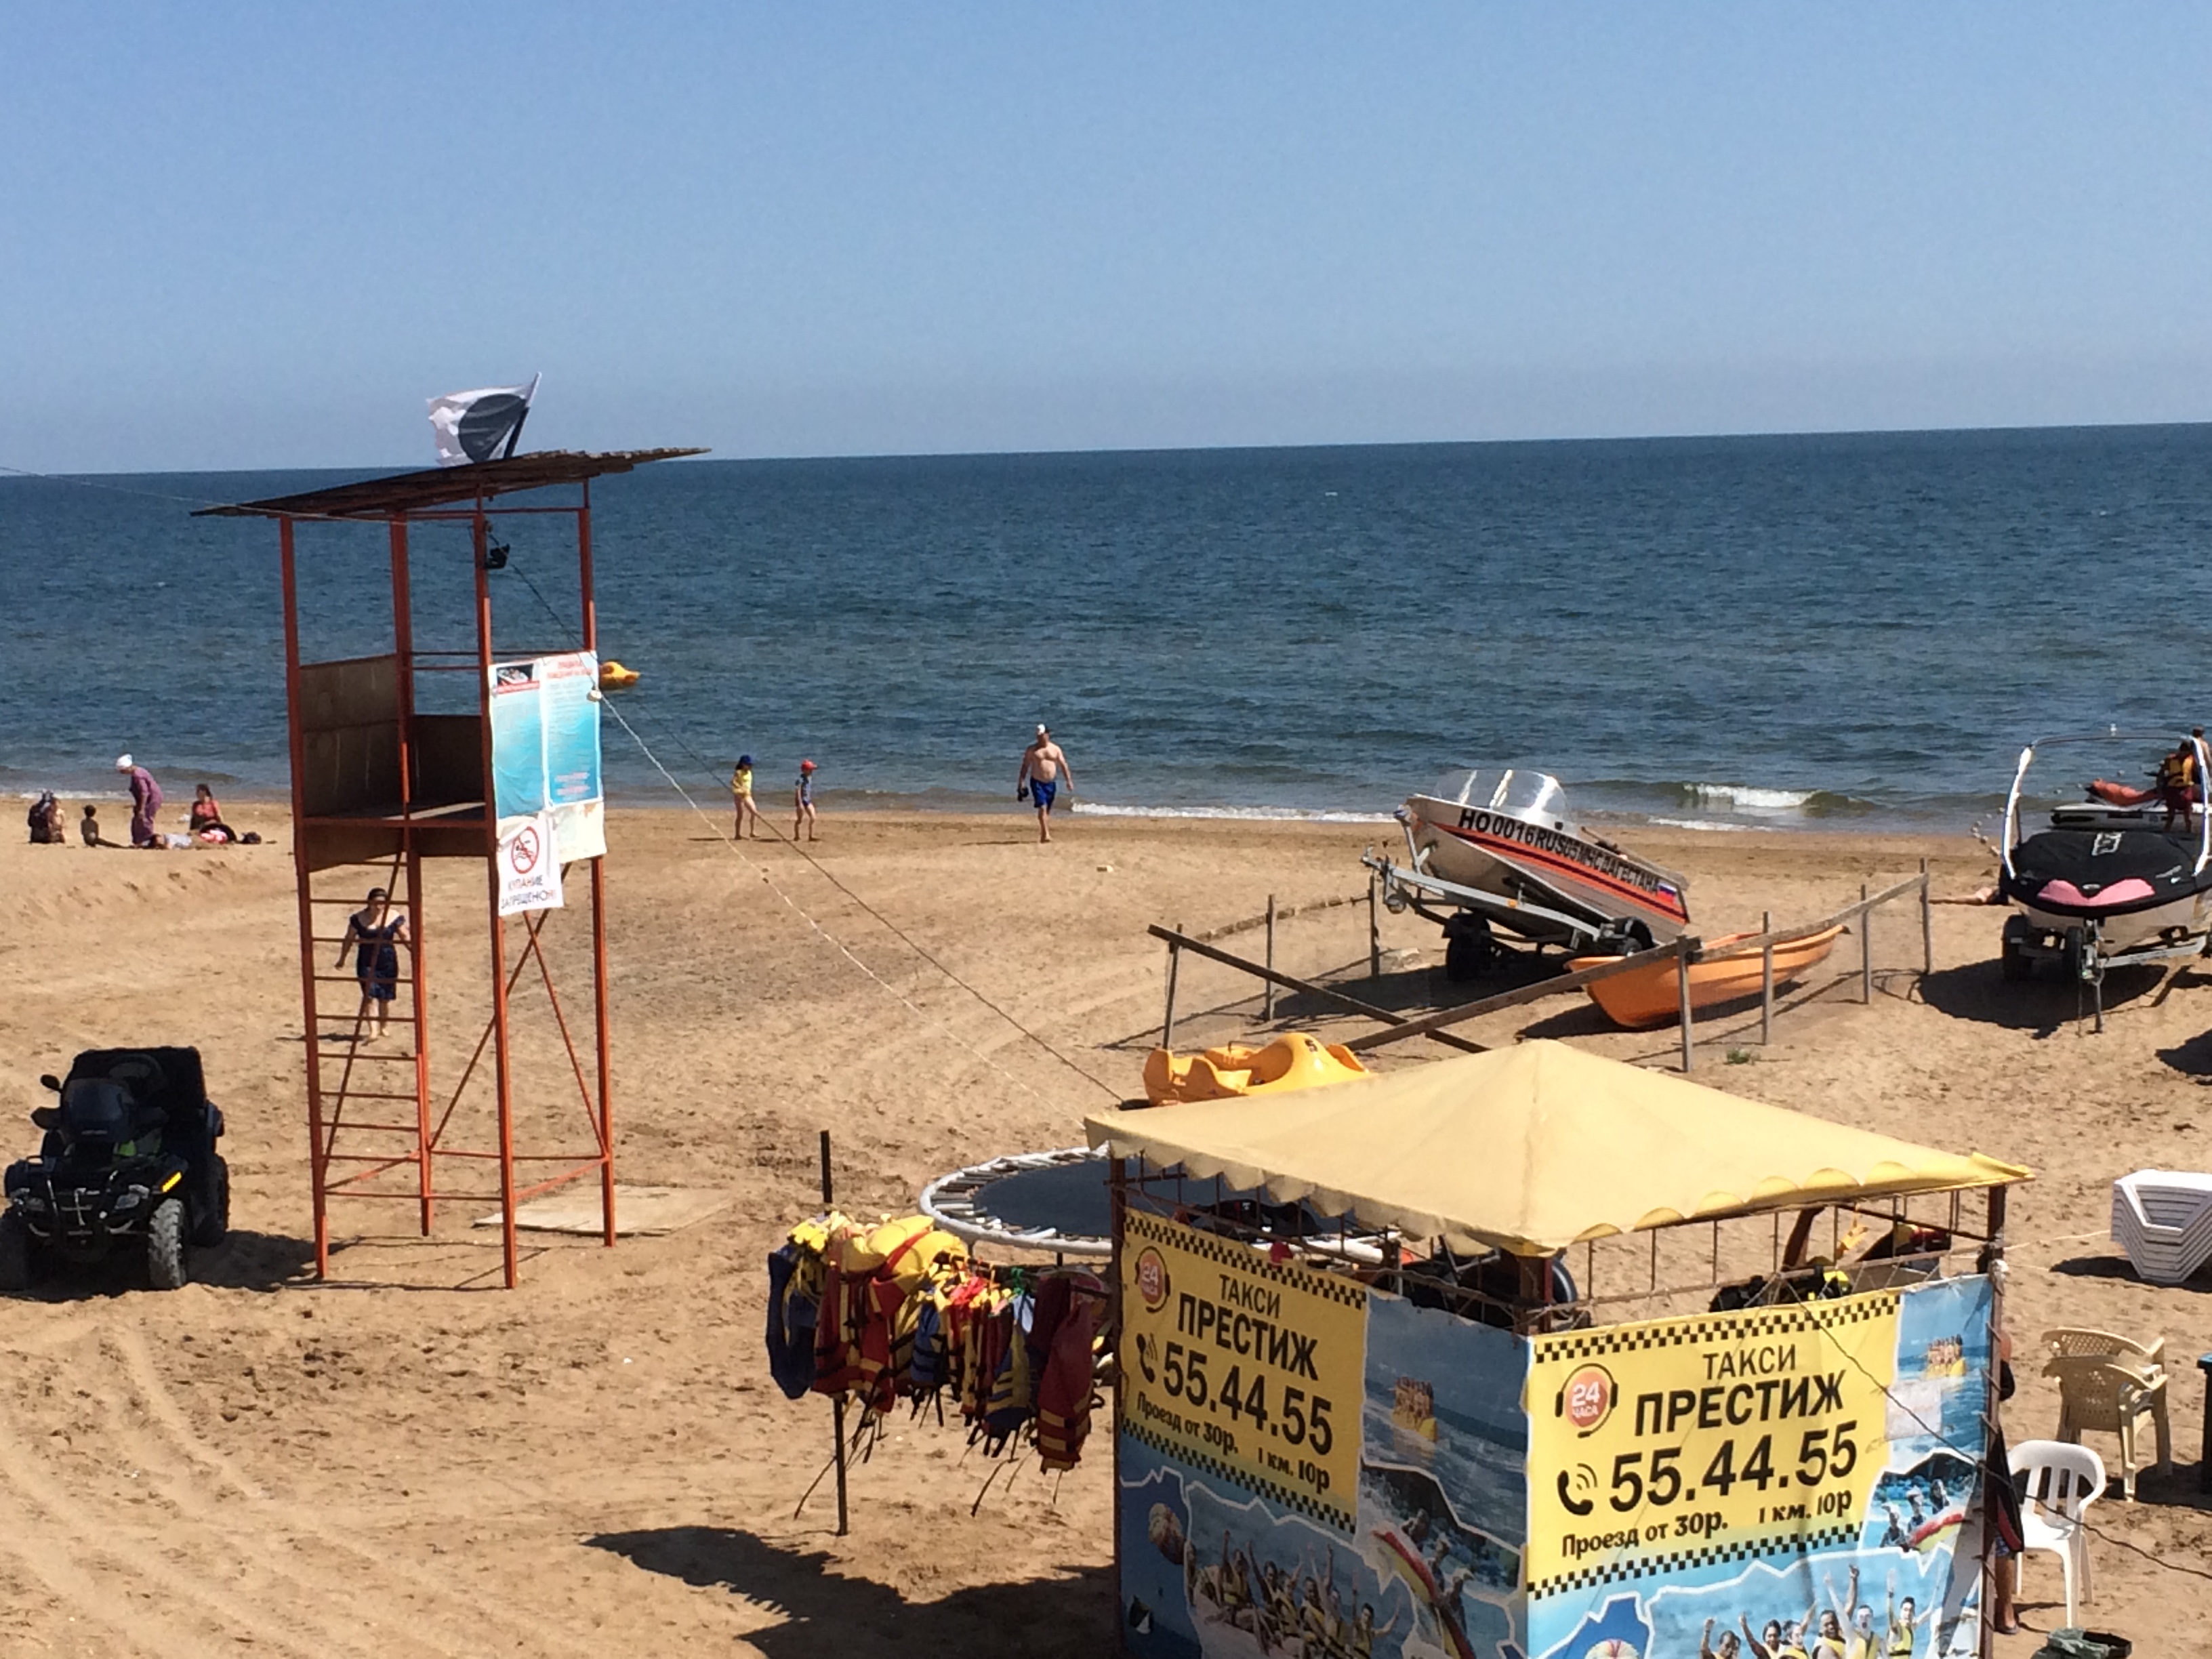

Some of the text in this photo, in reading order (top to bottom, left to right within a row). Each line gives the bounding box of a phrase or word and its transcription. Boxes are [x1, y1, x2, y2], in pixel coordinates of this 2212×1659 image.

[1219, 1273, 1280, 1319] ТАКСИ
[1178, 1292, 1318, 1381] ПРЕСТИЖ
[1703, 1344, 1797, 1380] ТАКСИ
[1136, 1391, 1182, 1434] Проезд
[1184, 1418, 1201, 1437] от
[1203, 1420, 1239, 1456] 30р.
[1163, 1340, 1332, 1456] 55.44.55
[1572, 1381, 1601, 1407] 24
[1634, 1370, 1846, 1437] ПРЕСТИЖ
[1609, 1420, 1858, 1513] 55.44.55
[1562, 1528, 1639, 1560] Проезд
[1645, 1523, 1668, 1542] от
[1674, 1511, 1729, 1540] 30р.
[1772, 1504, 1811, 1522] км.
[1817, 1490, 1852, 1518] 10р
